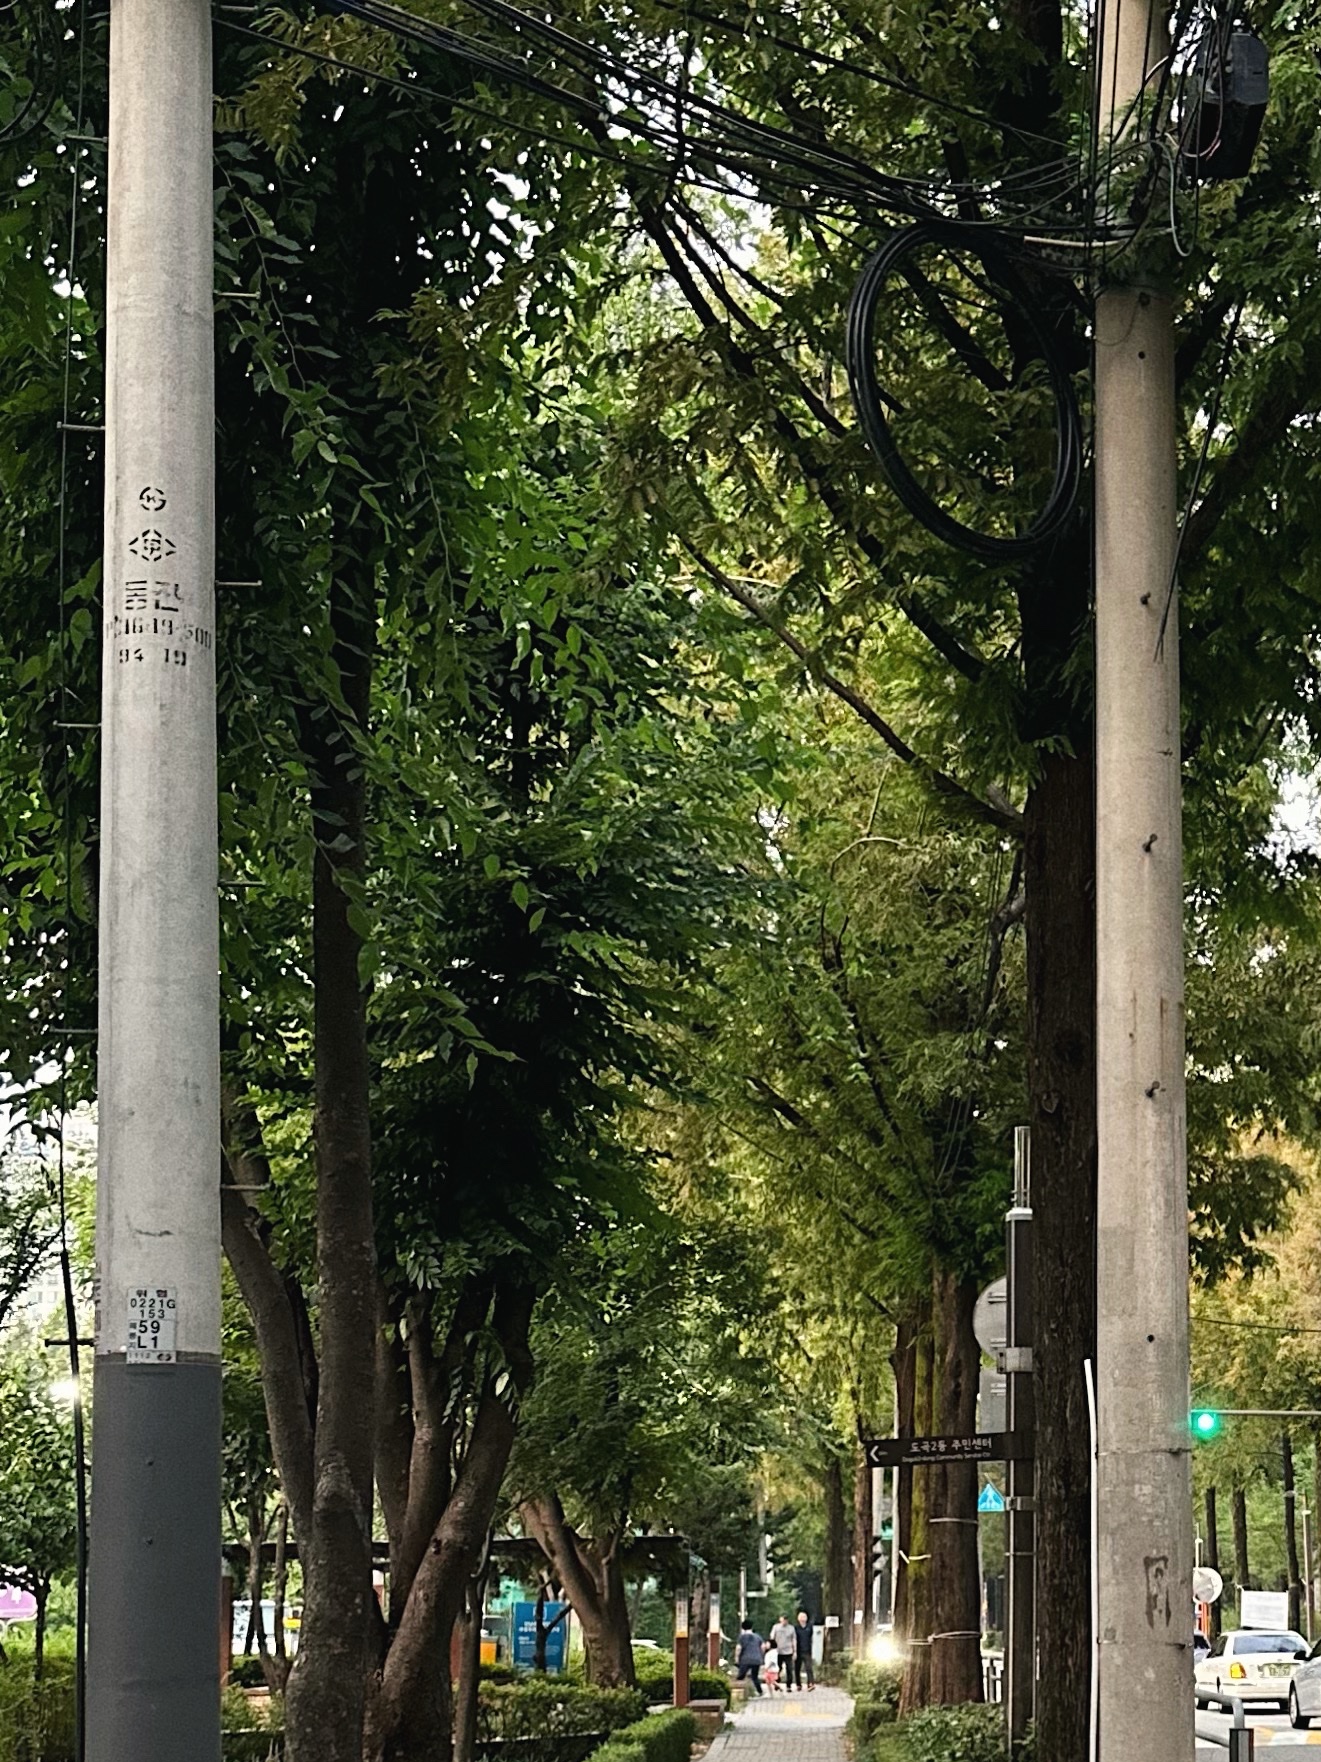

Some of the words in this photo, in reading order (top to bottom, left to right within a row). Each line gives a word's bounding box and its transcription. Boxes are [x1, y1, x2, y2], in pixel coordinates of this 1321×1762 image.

[130, 1298, 176, 1309] 0221G
[139, 1309, 165, 1319] 153
[138, 1320, 160, 1334] 59
[137, 1336, 158, 1349] L1
[910, 1440, 947, 1452] 도곡2동
[951, 1437, 992, 1451] 주민센터
